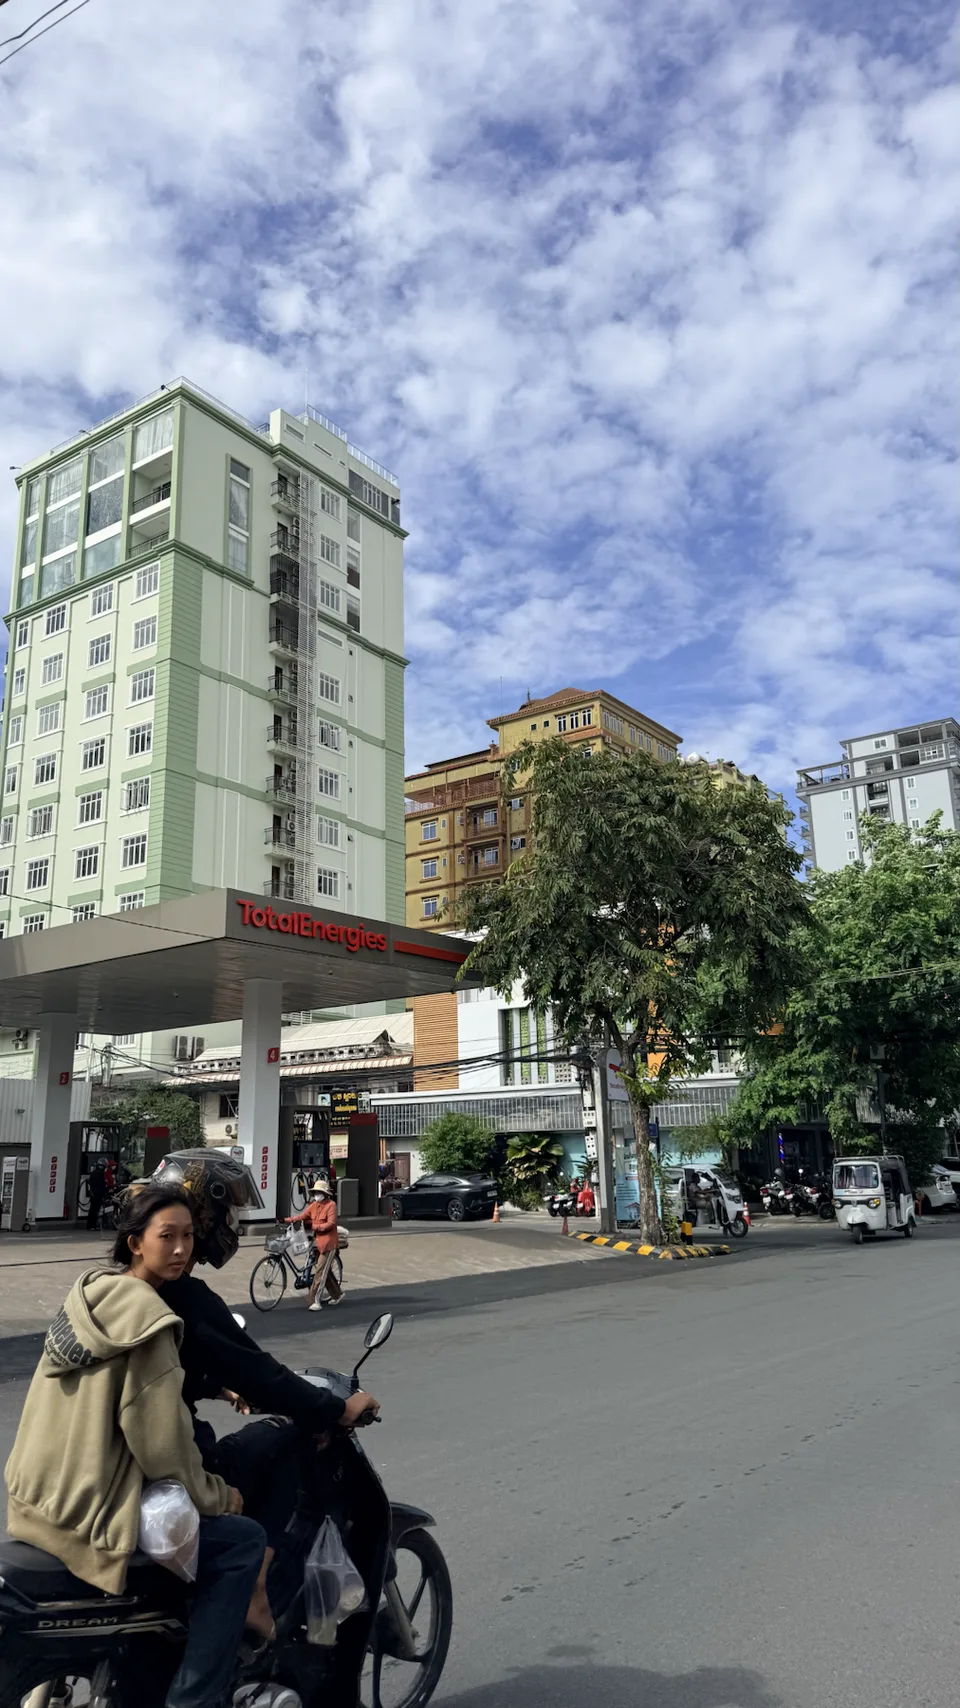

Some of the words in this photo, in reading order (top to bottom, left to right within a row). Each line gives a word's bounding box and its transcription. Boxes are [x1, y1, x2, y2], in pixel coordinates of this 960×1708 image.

[236, 899, 387, 953] TotalEnergies
[270, 1050, 275, 1060] 4
[61, 1074, 66, 1083] 2
[37, 1616, 118, 1628] DREAM
